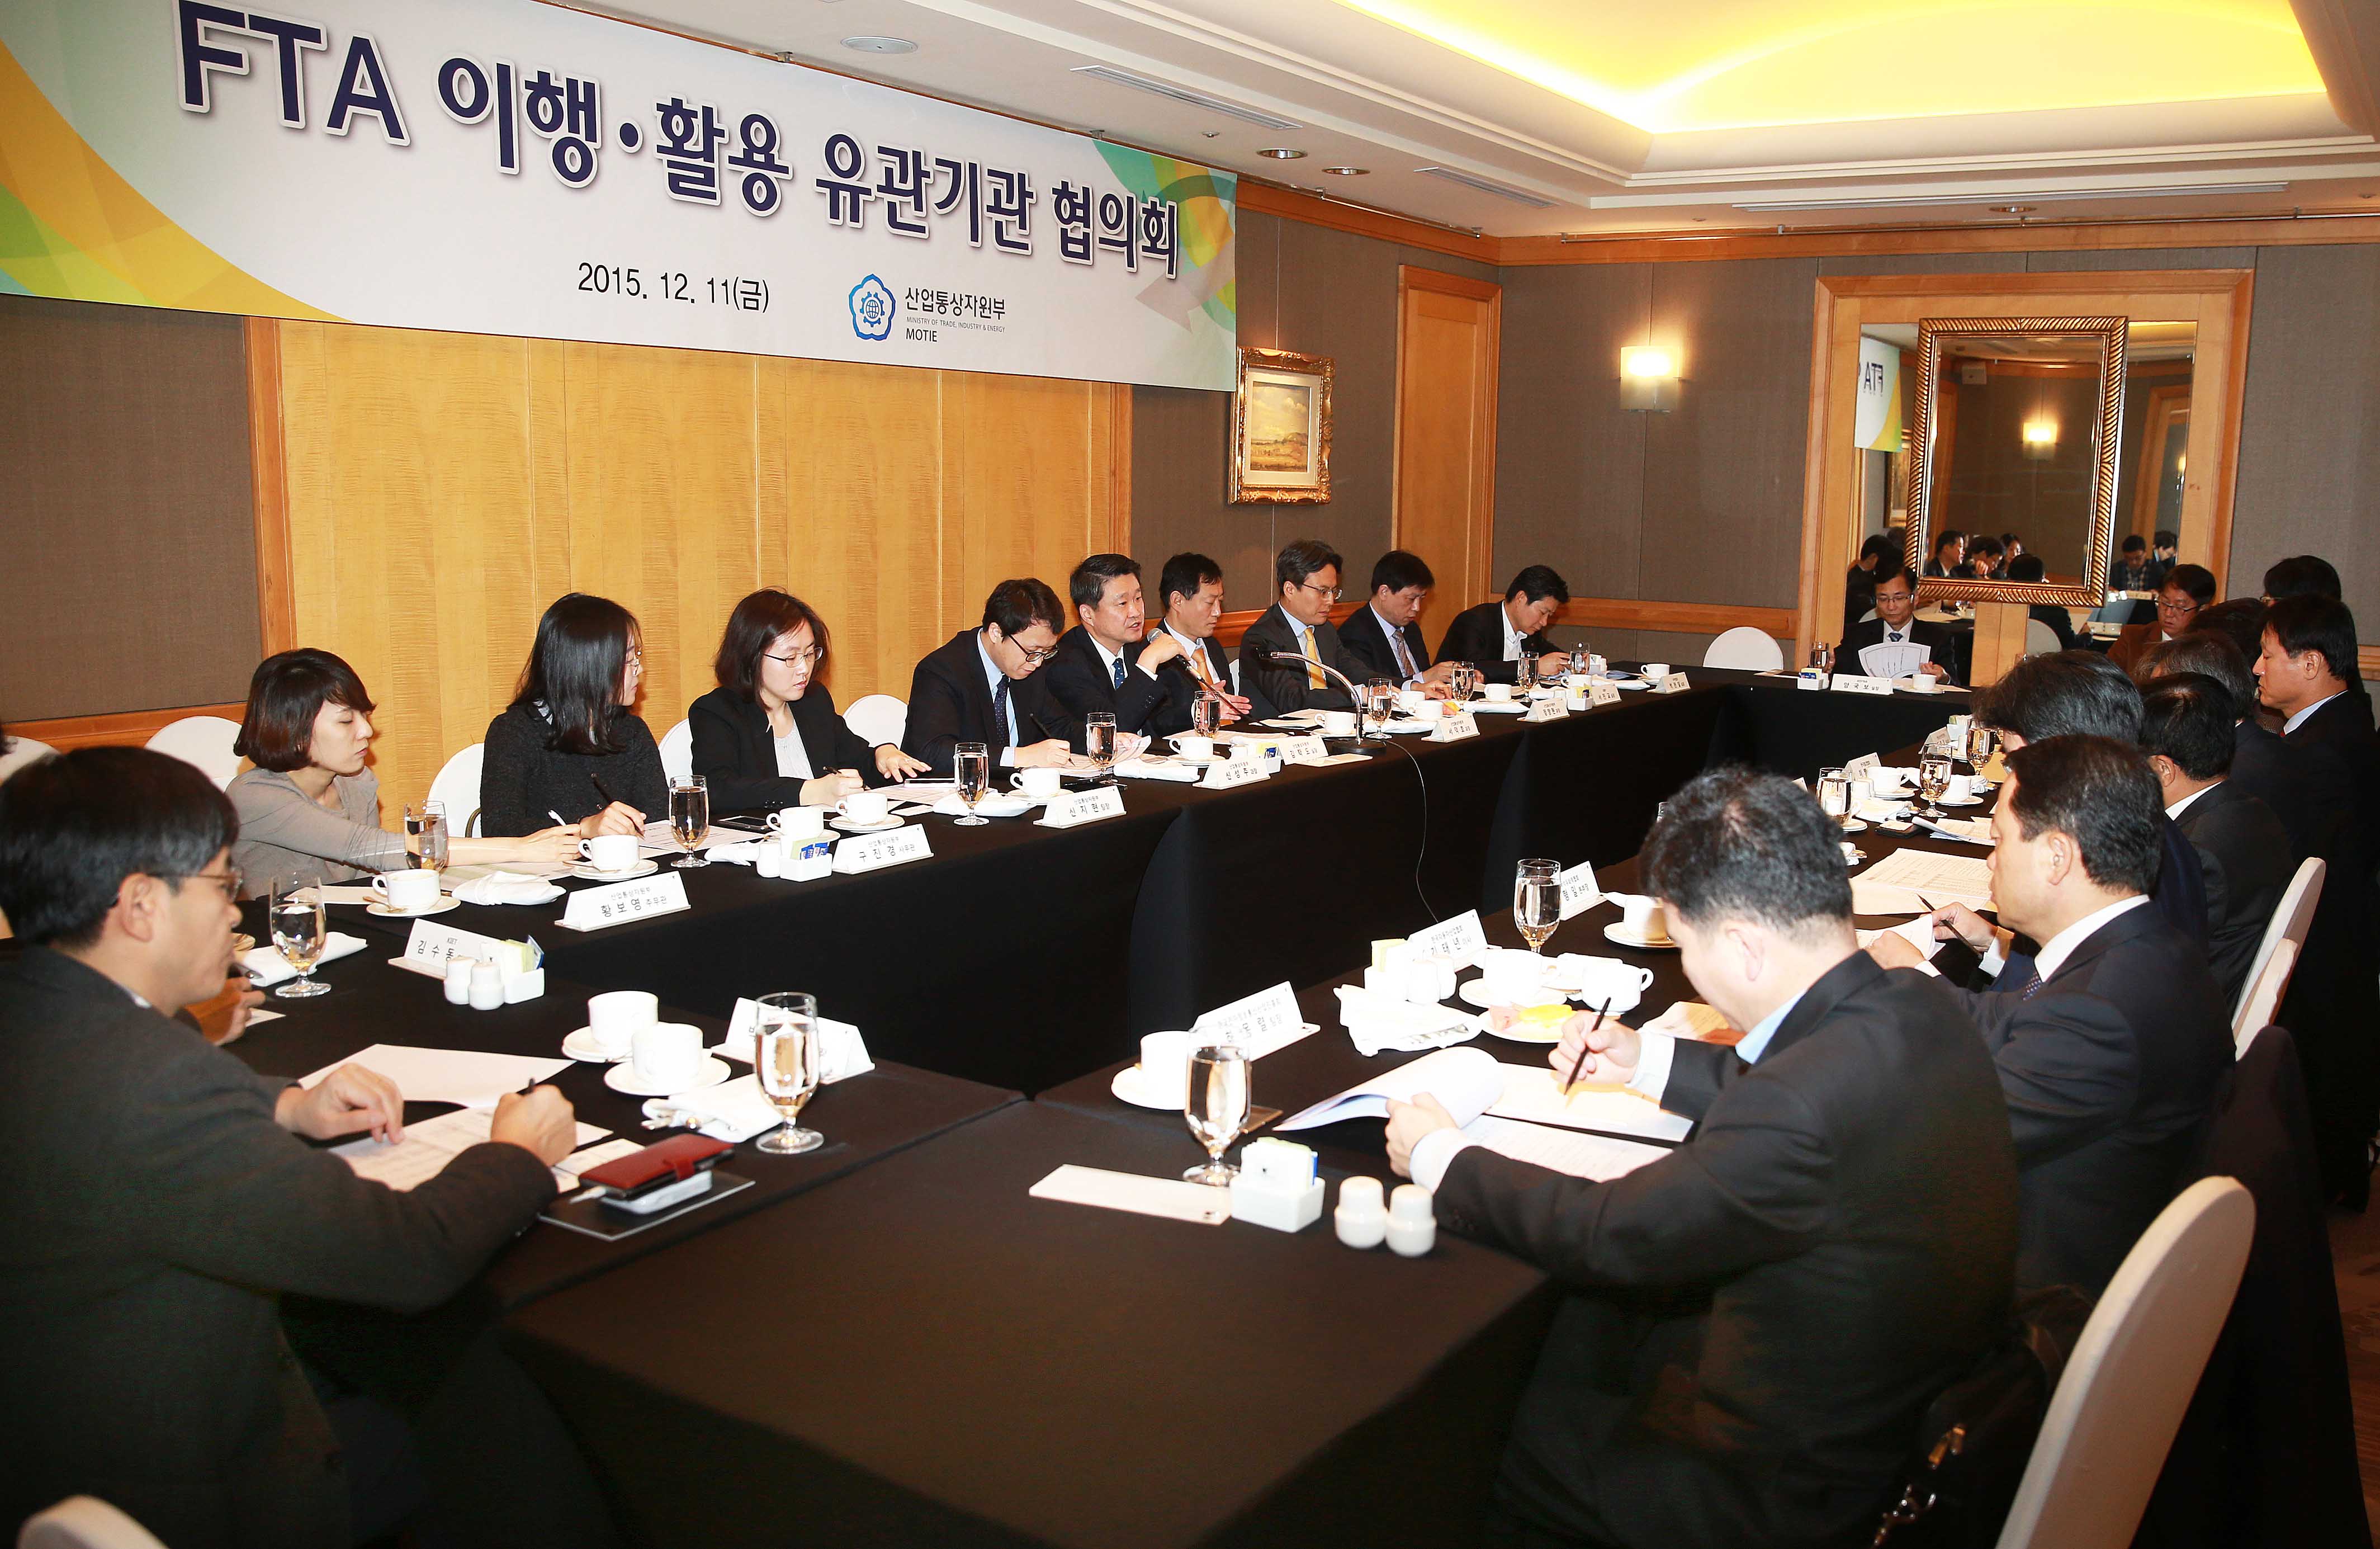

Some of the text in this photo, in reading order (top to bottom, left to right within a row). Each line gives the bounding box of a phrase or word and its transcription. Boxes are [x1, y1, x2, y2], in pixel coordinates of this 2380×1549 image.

[177, 0, 408, 143] FTA
[815, 133, 1034, 252] 유관기관
[1051, 180, 1176, 276] 협의회
[578, 262, 769, 313] 2015. 12. 11(금)
[905, 287, 1006, 320] 산업통상자원부
[906, 316, 930, 325] MINISTRY
[958, 322, 982, 330] INDUSTRY
[906, 328, 938, 342] MOTIE
